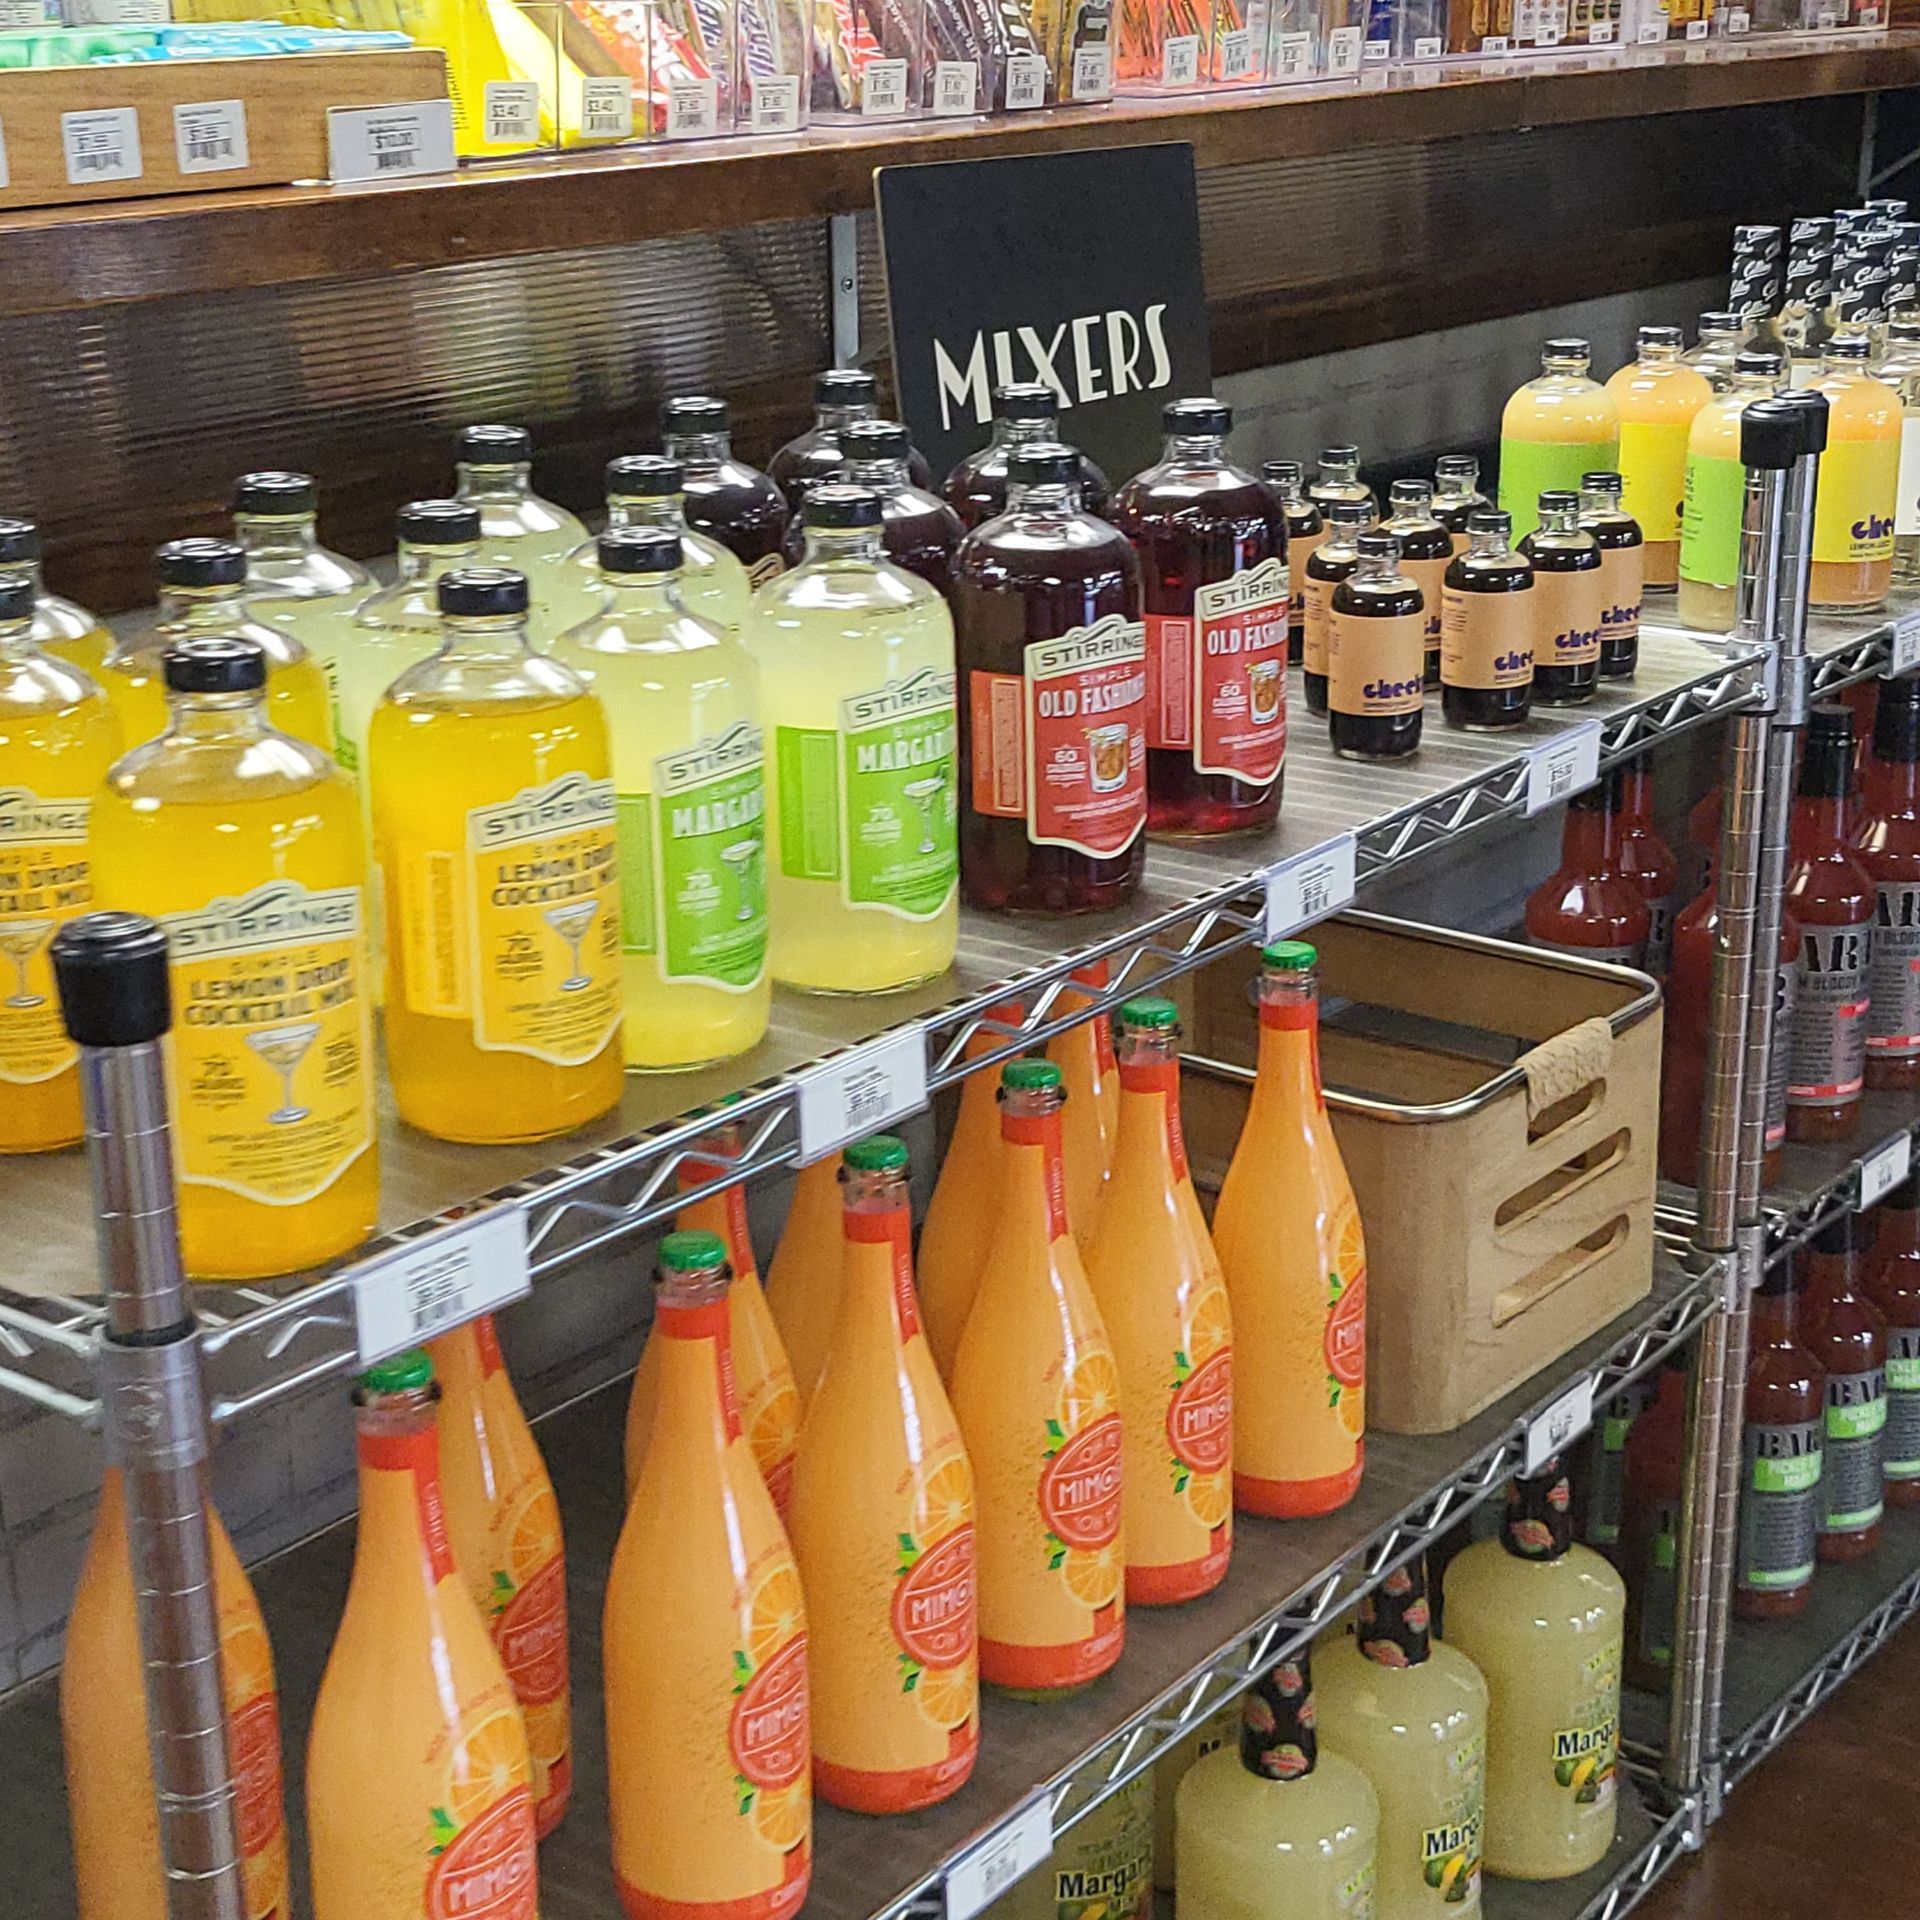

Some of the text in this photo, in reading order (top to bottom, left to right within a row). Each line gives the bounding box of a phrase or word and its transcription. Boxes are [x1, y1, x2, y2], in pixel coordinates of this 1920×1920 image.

[933, 303, 1168, 431] MIXERS
[1206, 629, 1240, 656] OLD
[1039, 689, 1078, 717] OLD
